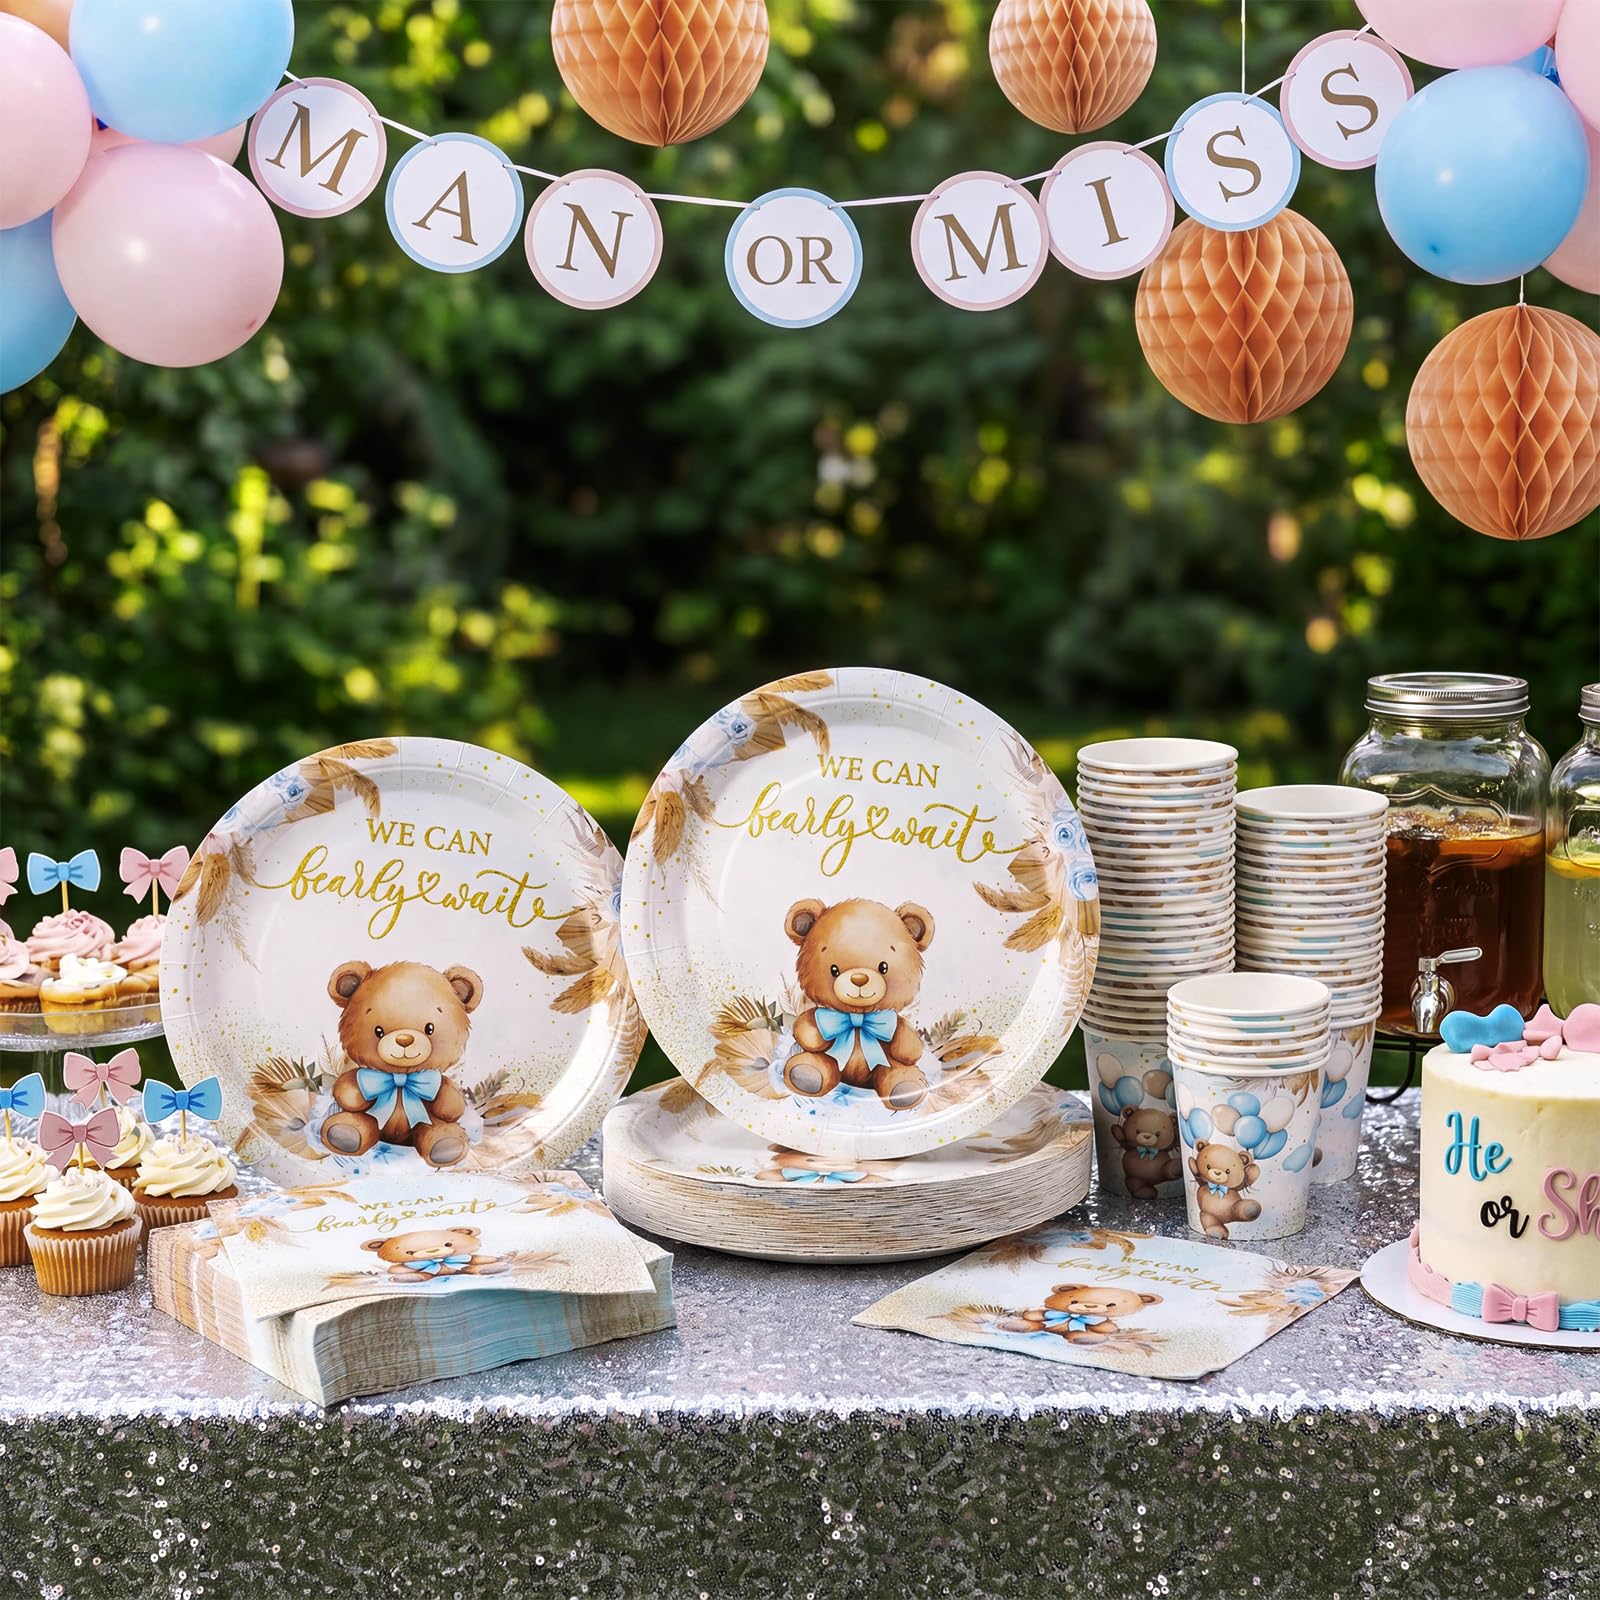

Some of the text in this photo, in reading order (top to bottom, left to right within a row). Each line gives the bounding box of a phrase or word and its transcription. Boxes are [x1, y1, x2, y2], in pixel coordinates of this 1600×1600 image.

[265, 63, 1378, 285] MAN OR MISS
[816, 753, 940, 788] WE CAN
[366, 818, 493, 856] WE CAN
[711, 782, 854, 876] bearly
[250, 845, 404, 939] bearly
[1444, 1111, 1513, 1182] He
[360, 1195, 444, 1211] WE CAN
[1480, 1195, 1530, 1239] or
[1120, 1256, 1199, 1274] WE CAN
